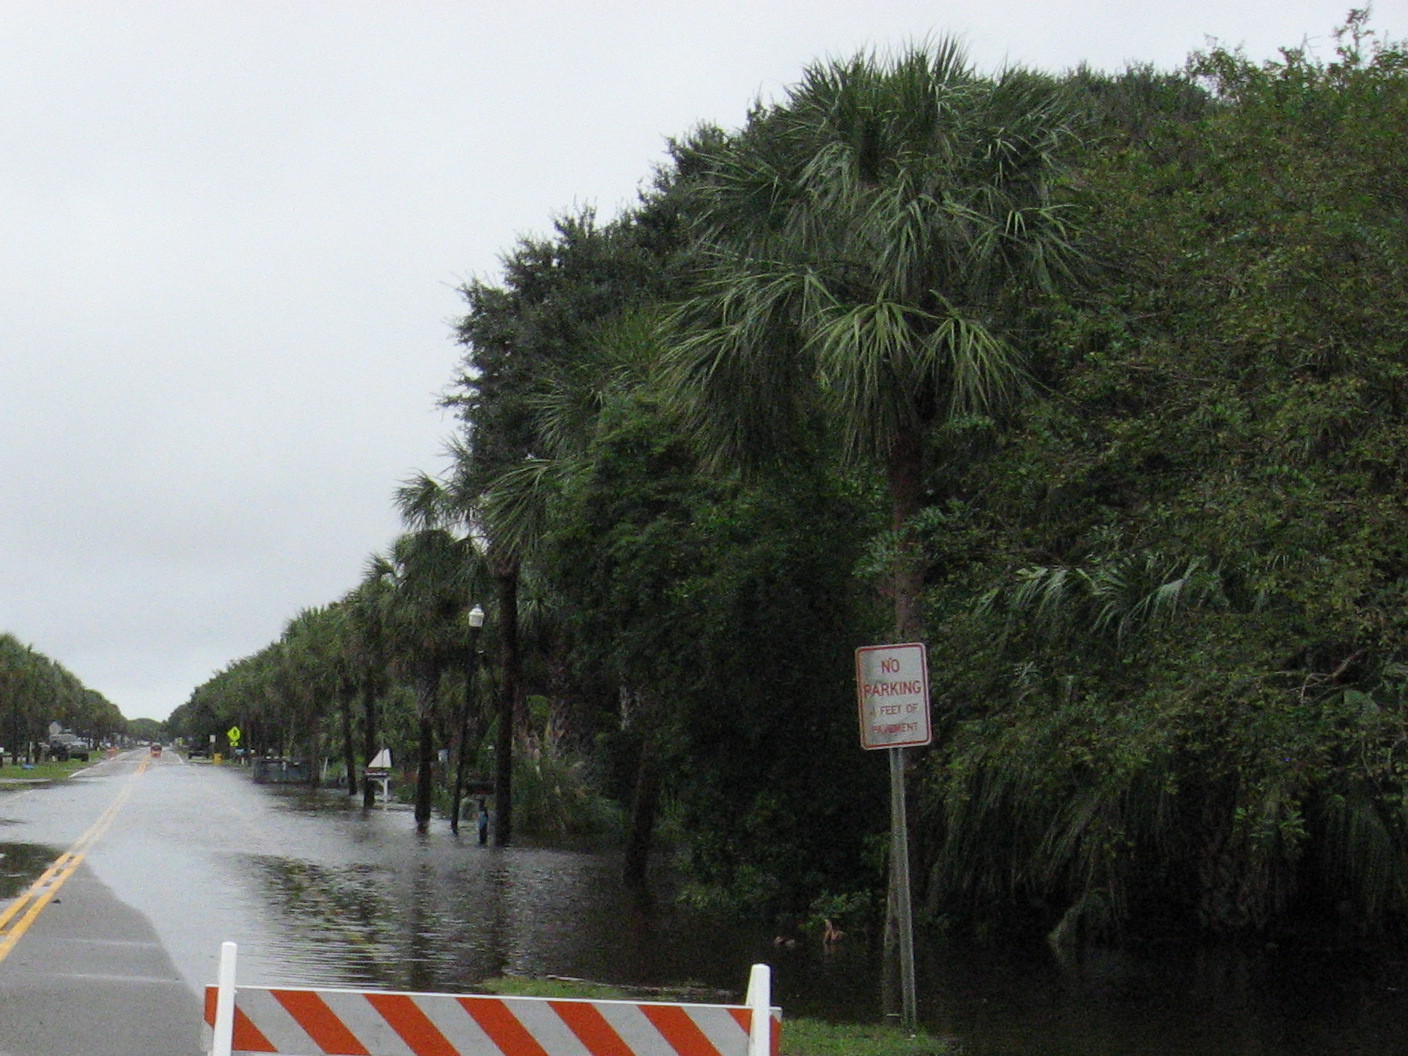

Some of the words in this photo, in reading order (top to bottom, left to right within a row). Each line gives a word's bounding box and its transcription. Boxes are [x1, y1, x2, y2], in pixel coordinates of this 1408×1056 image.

[881, 658, 900, 674] NO
[863, 680, 922, 698] PARKING
[880, 704, 902, 715] FEET
[905, 703, 919, 714] OF
